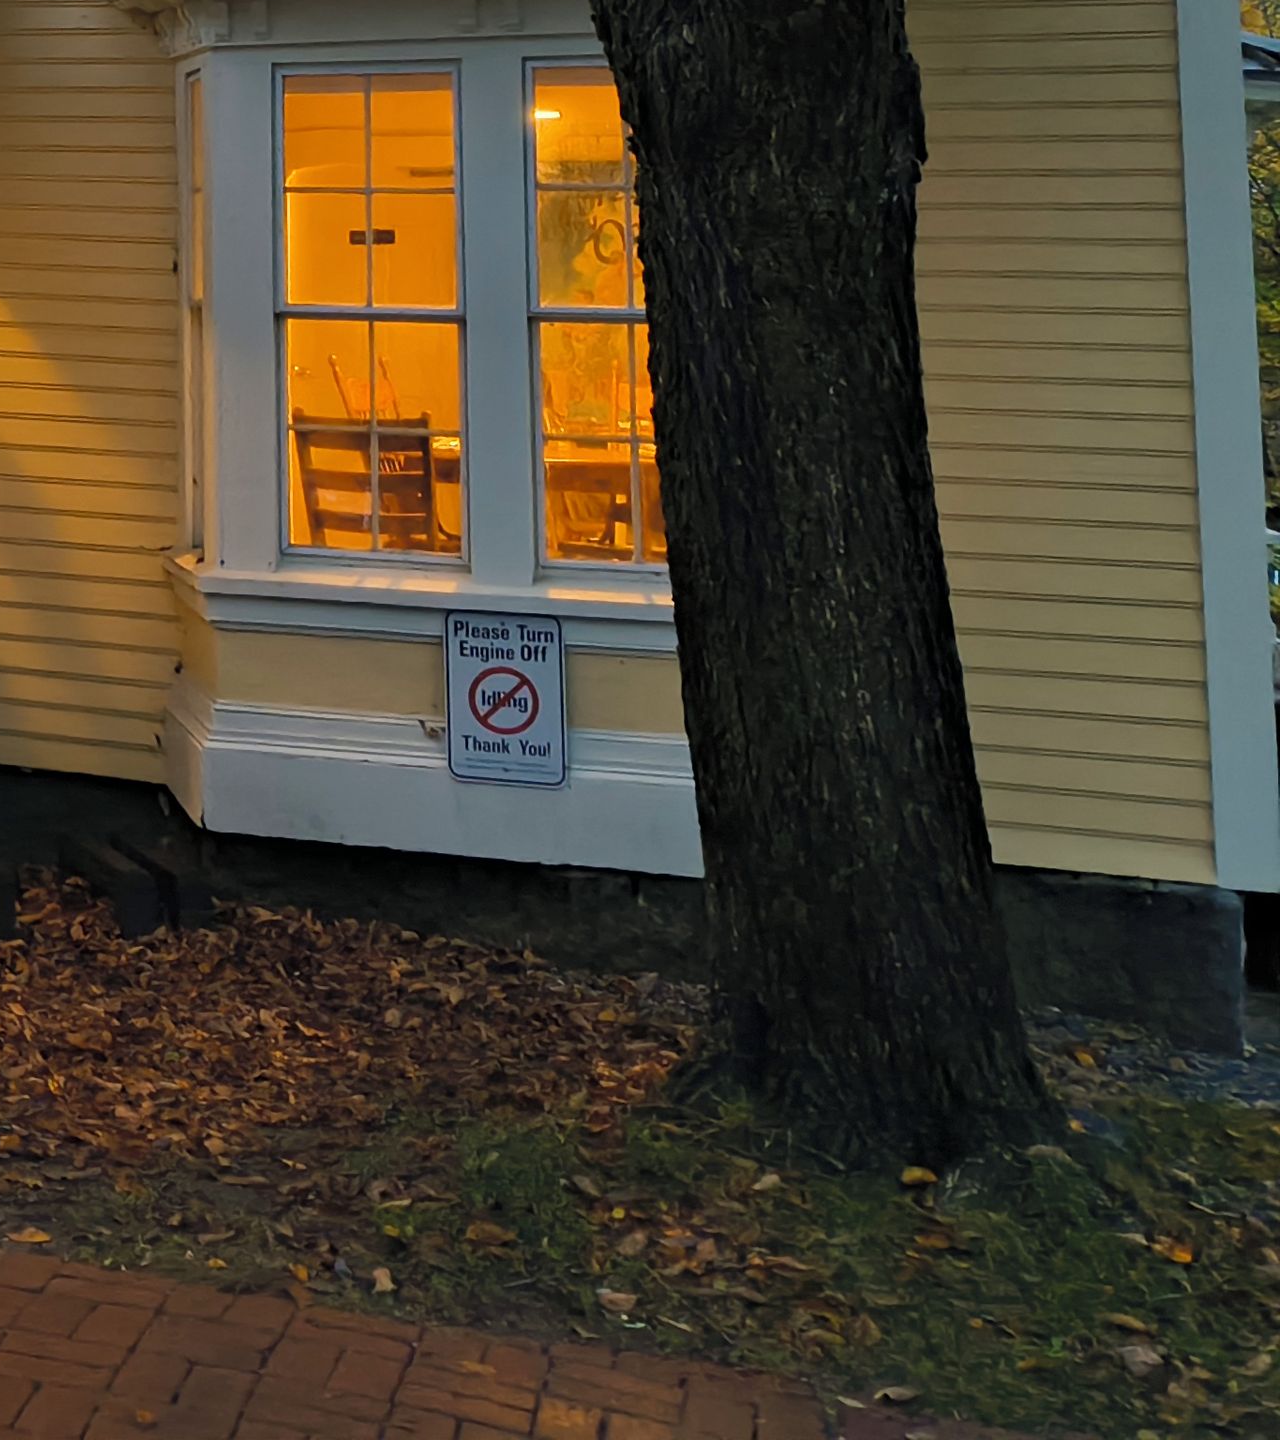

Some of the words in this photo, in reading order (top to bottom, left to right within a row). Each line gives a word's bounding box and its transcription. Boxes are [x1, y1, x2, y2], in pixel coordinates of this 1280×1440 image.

[453, 620, 510, 641] Please
[516, 623, 555, 644] Turn
[459, 640, 515, 663] Engine
[520, 644, 548, 663] Off
[461, 734, 511, 755] Thank
[518, 738, 552, 759] You!
